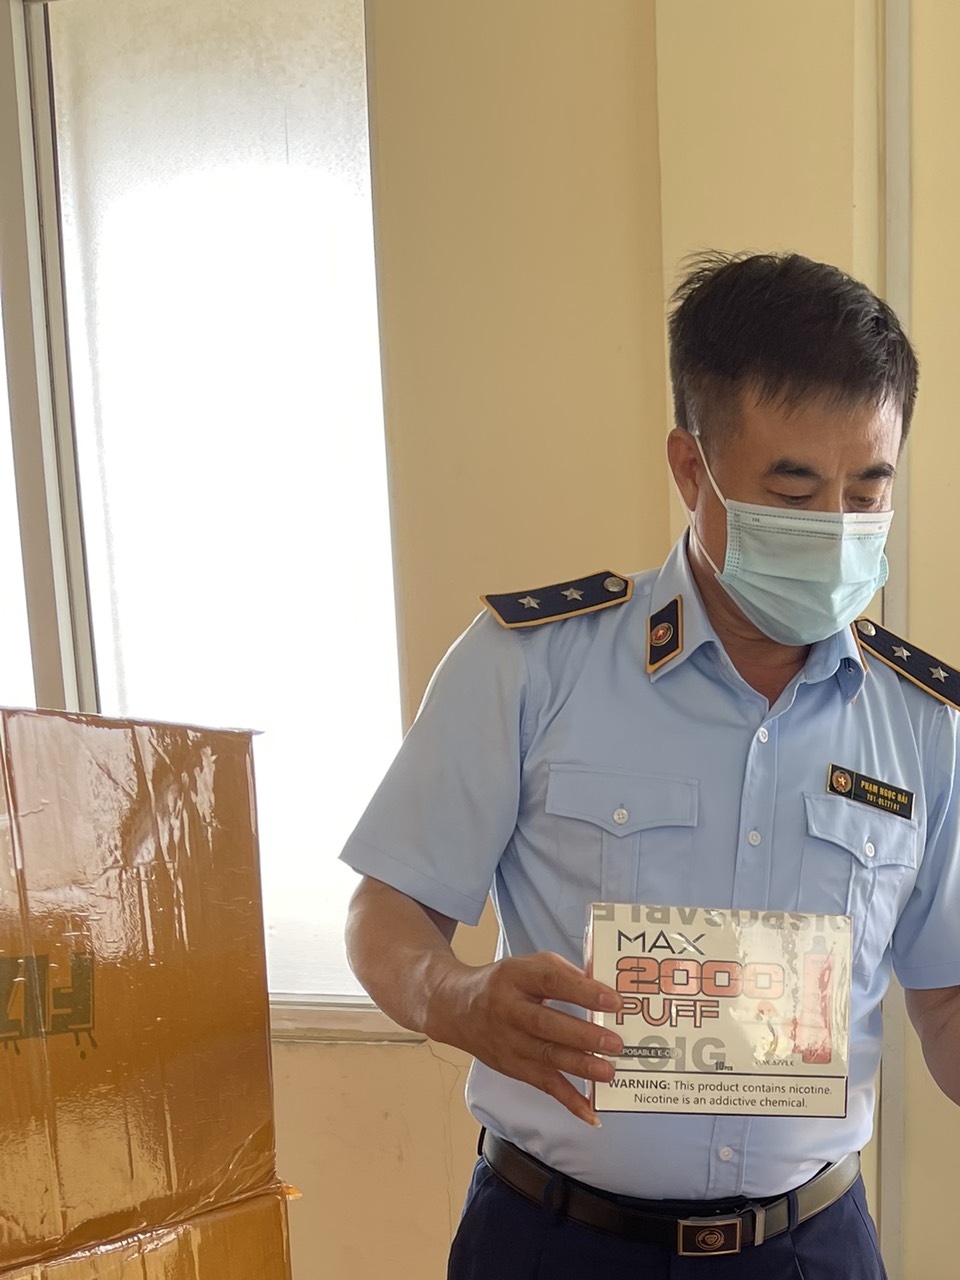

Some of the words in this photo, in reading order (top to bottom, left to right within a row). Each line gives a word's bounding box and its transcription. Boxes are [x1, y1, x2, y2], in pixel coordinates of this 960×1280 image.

[617, 929, 706, 955] MAX
[615, 955, 785, 999] 2000
[615, 996, 720, 1028] PUFF
[608, 1077, 671, 1090] WARNING:
[674, 1080, 695, 1091] This
[697, 1081, 739, 1093] product
[742, 1083, 786, 1094] contains
[789, 1084, 832, 1095] nicotine.
[634, 1093, 679, 1105] Nicotine
[682, 1094, 690, 1104] is
[693, 1096, 706, 1105] an
[709, 1095, 757, 1106] addictive
[760, 1097, 807, 1108] chemical.
